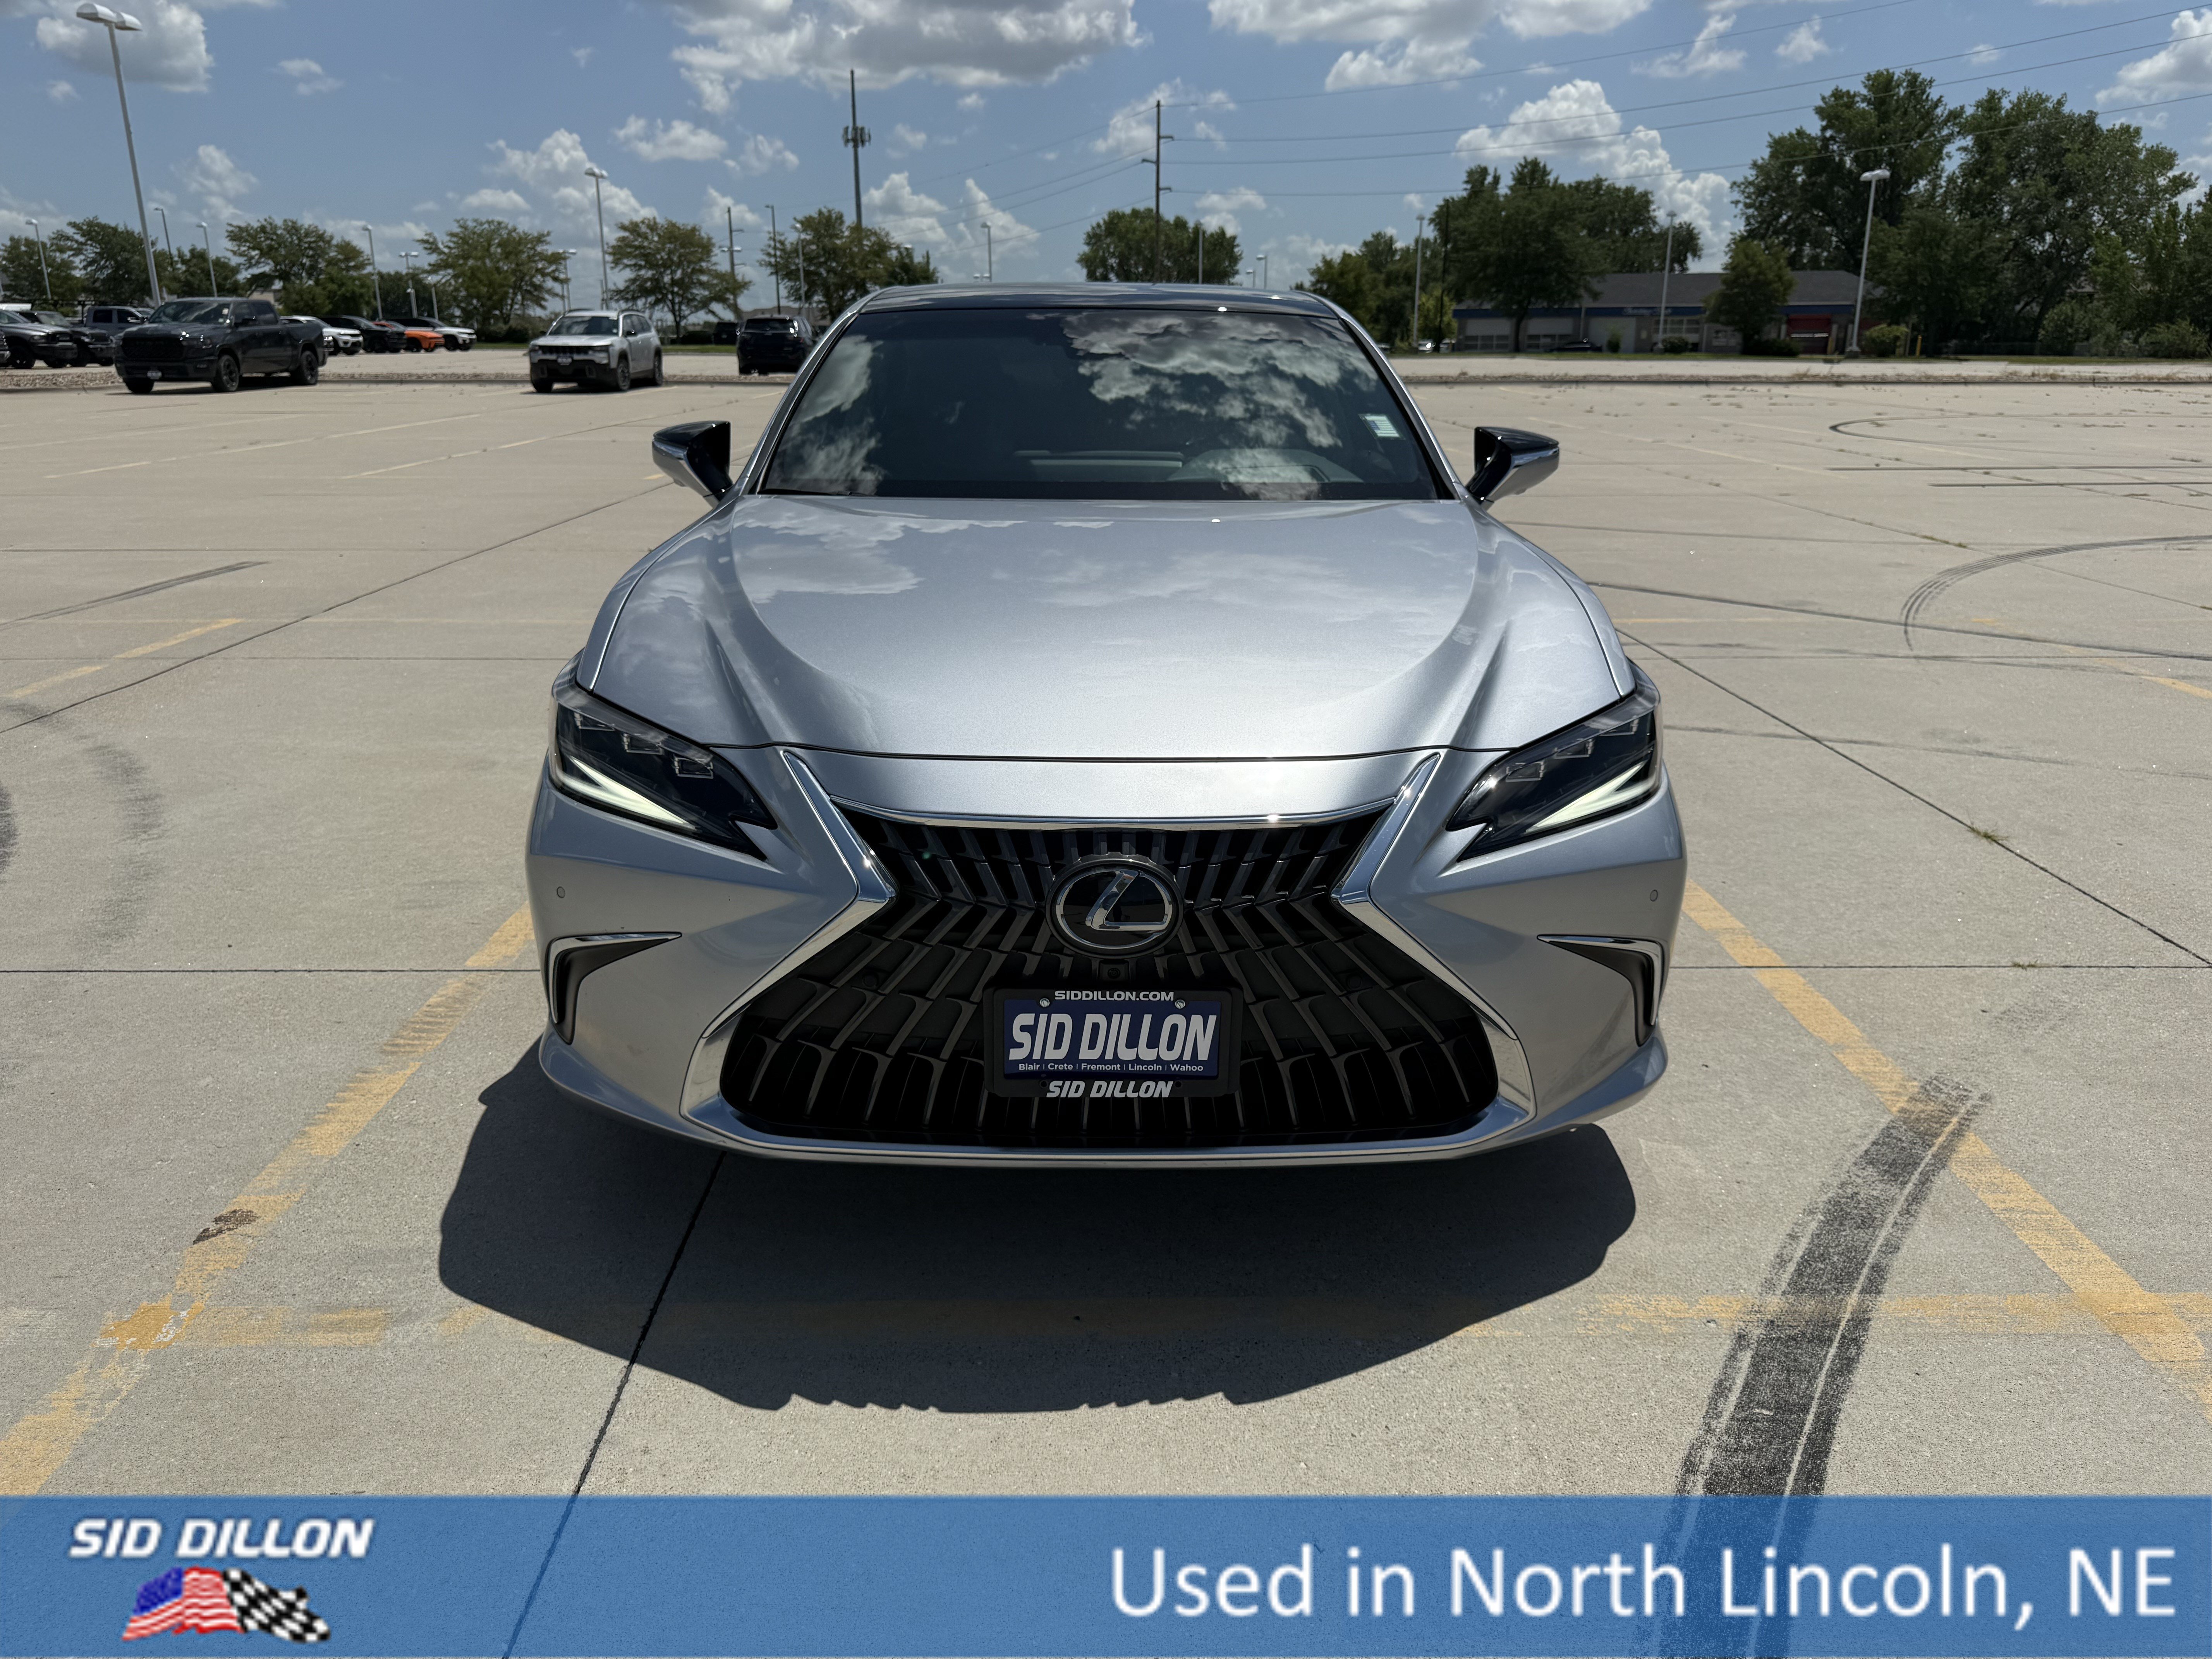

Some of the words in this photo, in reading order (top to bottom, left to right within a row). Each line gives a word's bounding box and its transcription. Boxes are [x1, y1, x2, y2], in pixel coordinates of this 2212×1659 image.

[1054, 990, 1174, 1001] SIDDILLON.COM
[1009, 1013, 1073, 1060] SID
[1079, 1013, 1217, 1061] DILLON
[1046, 1080, 1085, 1098] SID
[1089, 1081, 1173, 1098] DILLON
